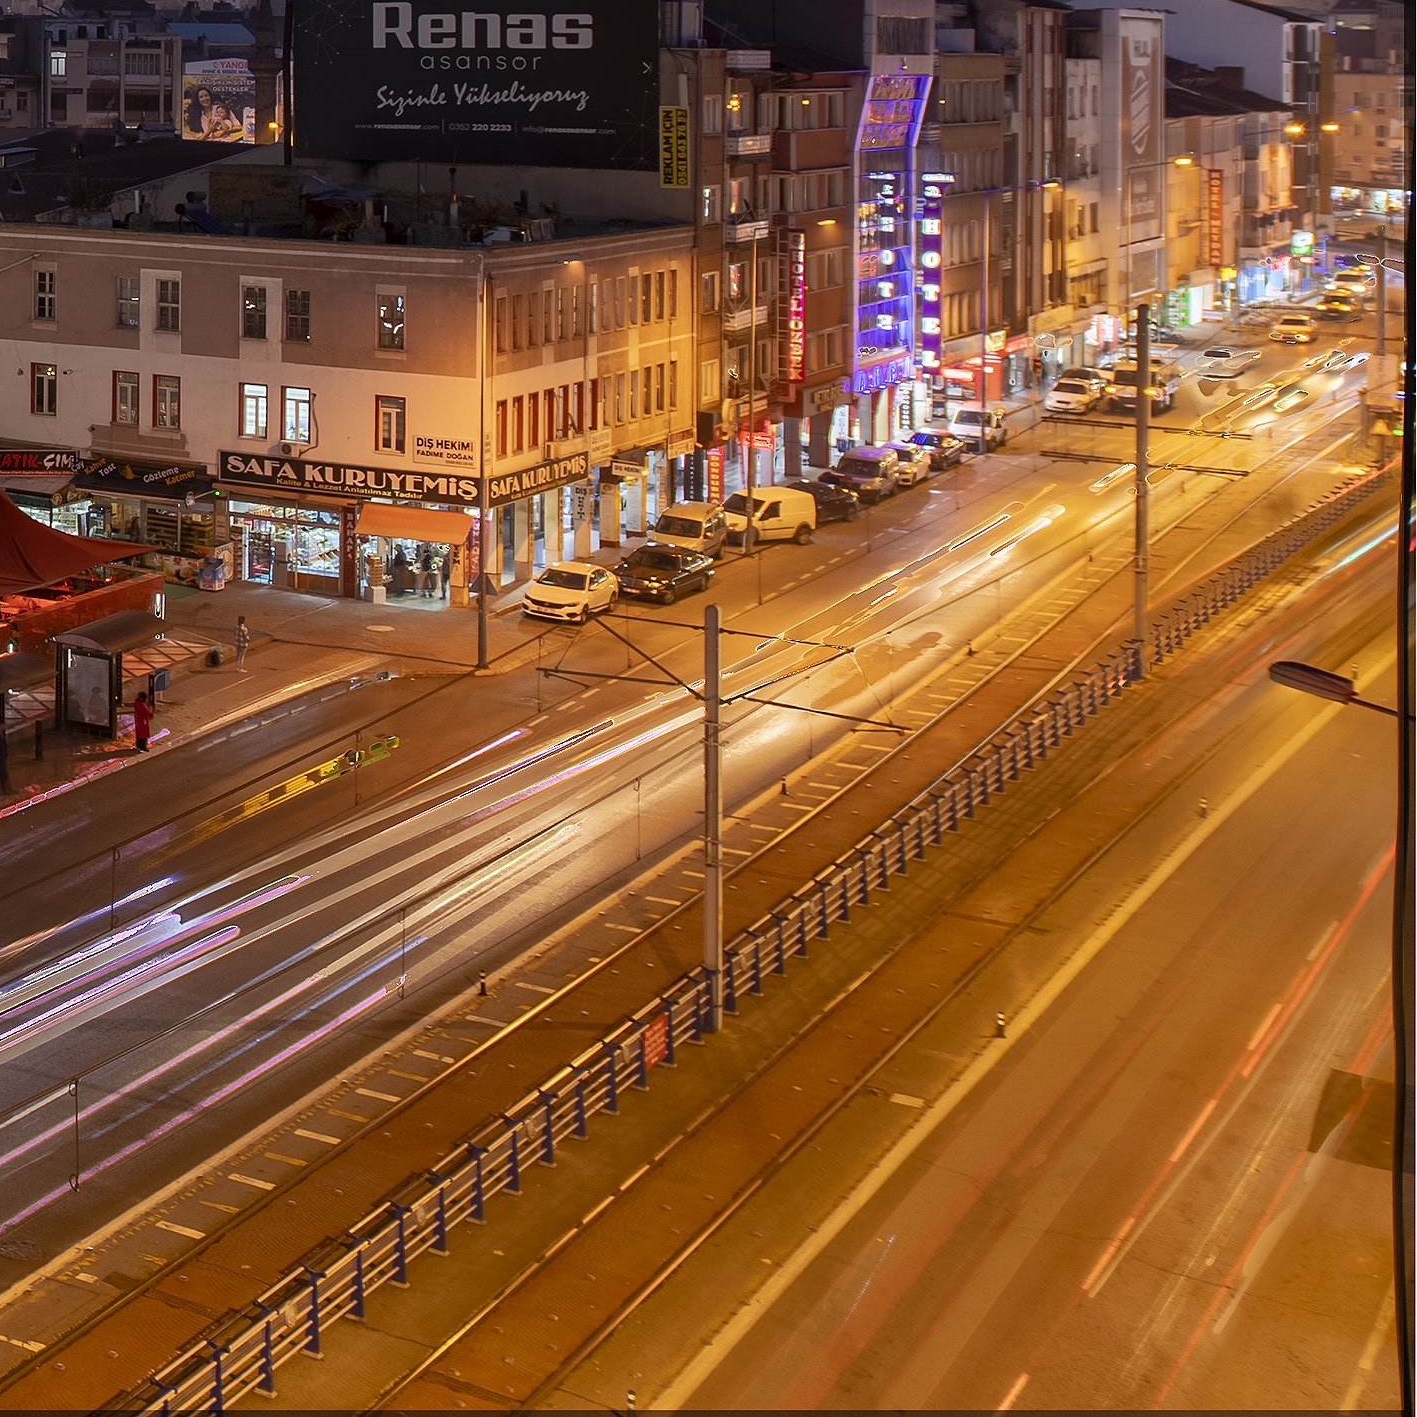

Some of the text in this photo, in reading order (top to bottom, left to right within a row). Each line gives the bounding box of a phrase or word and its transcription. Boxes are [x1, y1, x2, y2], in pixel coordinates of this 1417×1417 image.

[372, 1, 594, 49] Renas
[376, 80, 591, 117] Sizinle Yükseliyoruz
[472, 123, 489, 131] 220
[490, 124, 512, 132] 2233
[662, 135, 673, 185] REKLAM
[416, 437, 434, 450] DİŞ
[99, 463, 117, 477] Tost
[143, 466, 180, 483] Gözleme
[227, 455, 298, 480] SAFA
[304, 463, 479, 501] KURUYEMİŞ
[276, 478, 302, 487] Kalite
[312, 482, 343, 492] Lezzet
[490, 475, 521, 499] SAFA
